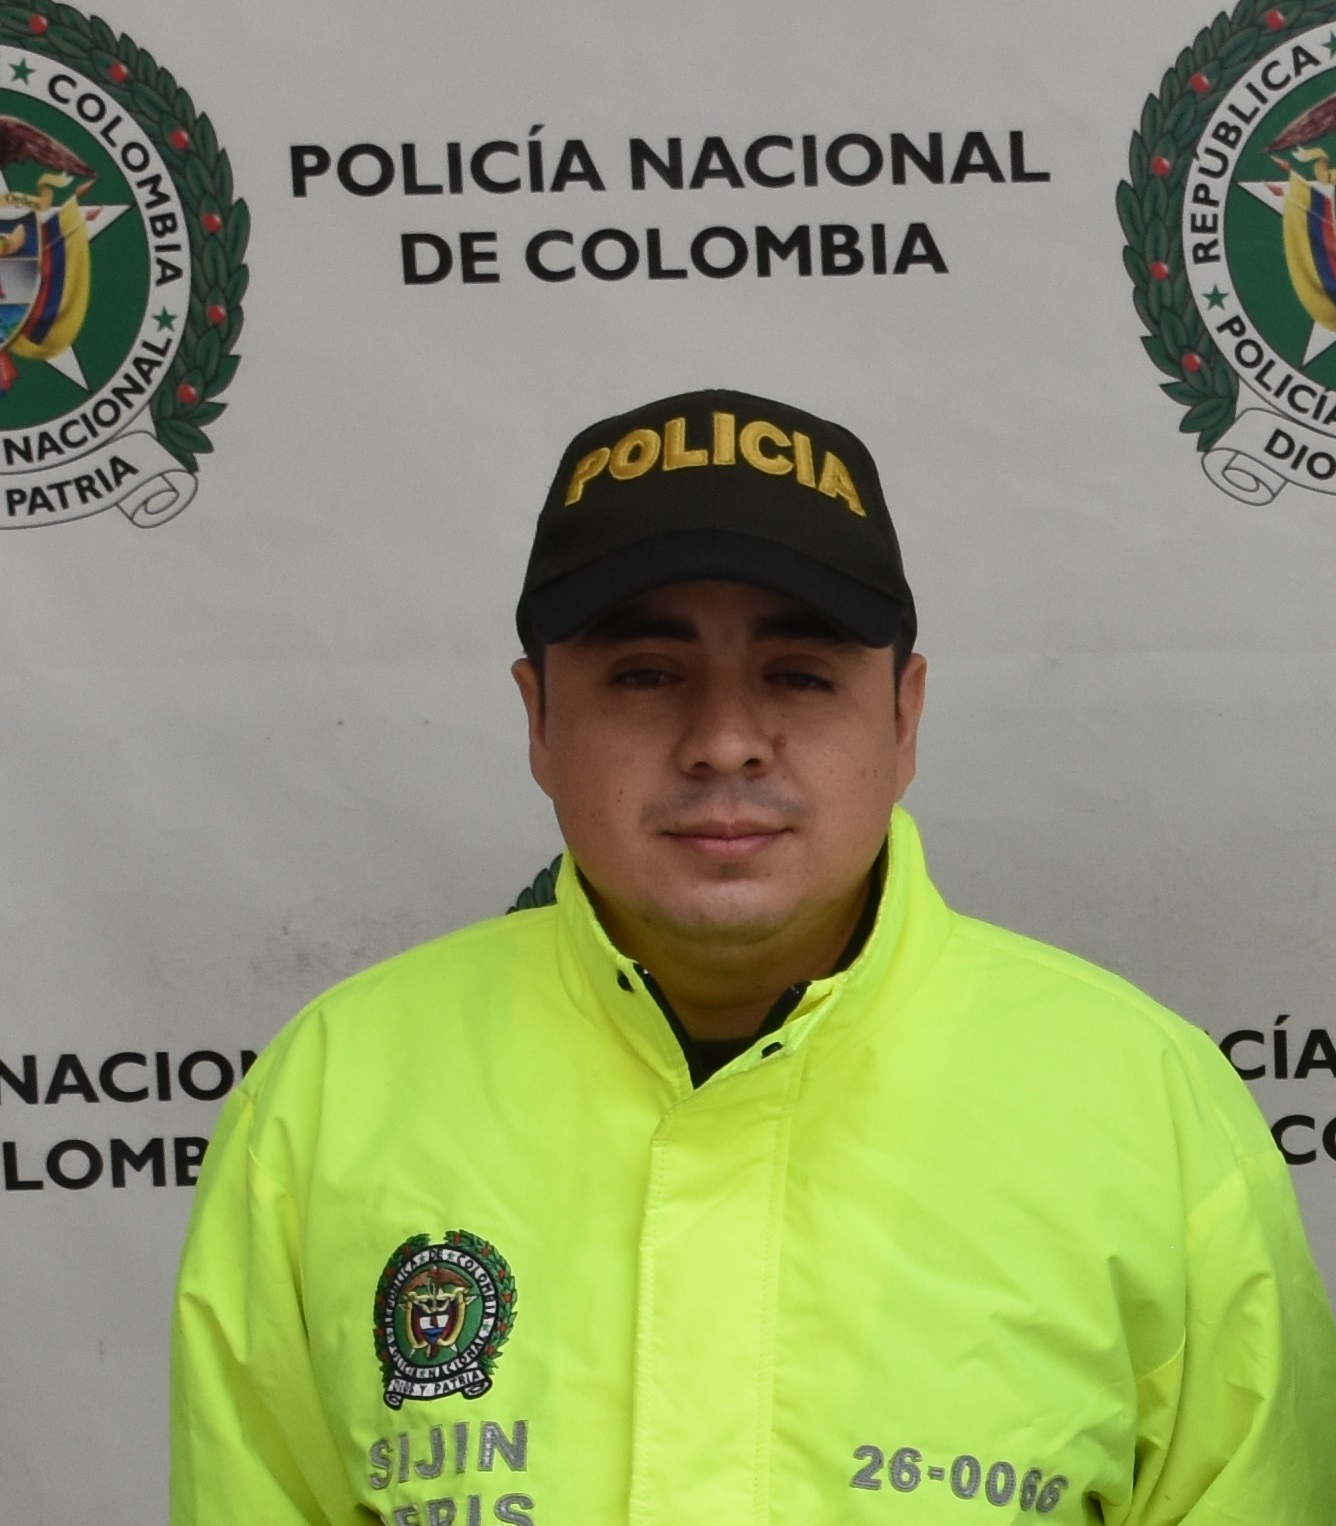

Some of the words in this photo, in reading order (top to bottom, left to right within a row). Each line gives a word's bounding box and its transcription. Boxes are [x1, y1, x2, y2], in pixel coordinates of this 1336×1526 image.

[48, 74, 183, 286] COLOMBIA
[289, 125, 607, 197] POLICÍA
[629, 130, 1050, 191] NACIONAL
[1193, 45, 1320, 264] REPÚBLICA
[401, 230, 500, 284] DE
[524, 222, 948, 281] COLOMBIA
[4, 337, 172, 465] NACIONAL
[6, 455, 139, 516] PATRIA
[564, 412, 866, 517] POLICIA
[369, 1420, 528, 1490] SIJIN
[850, 1444, 1069, 1514] 26-0066
